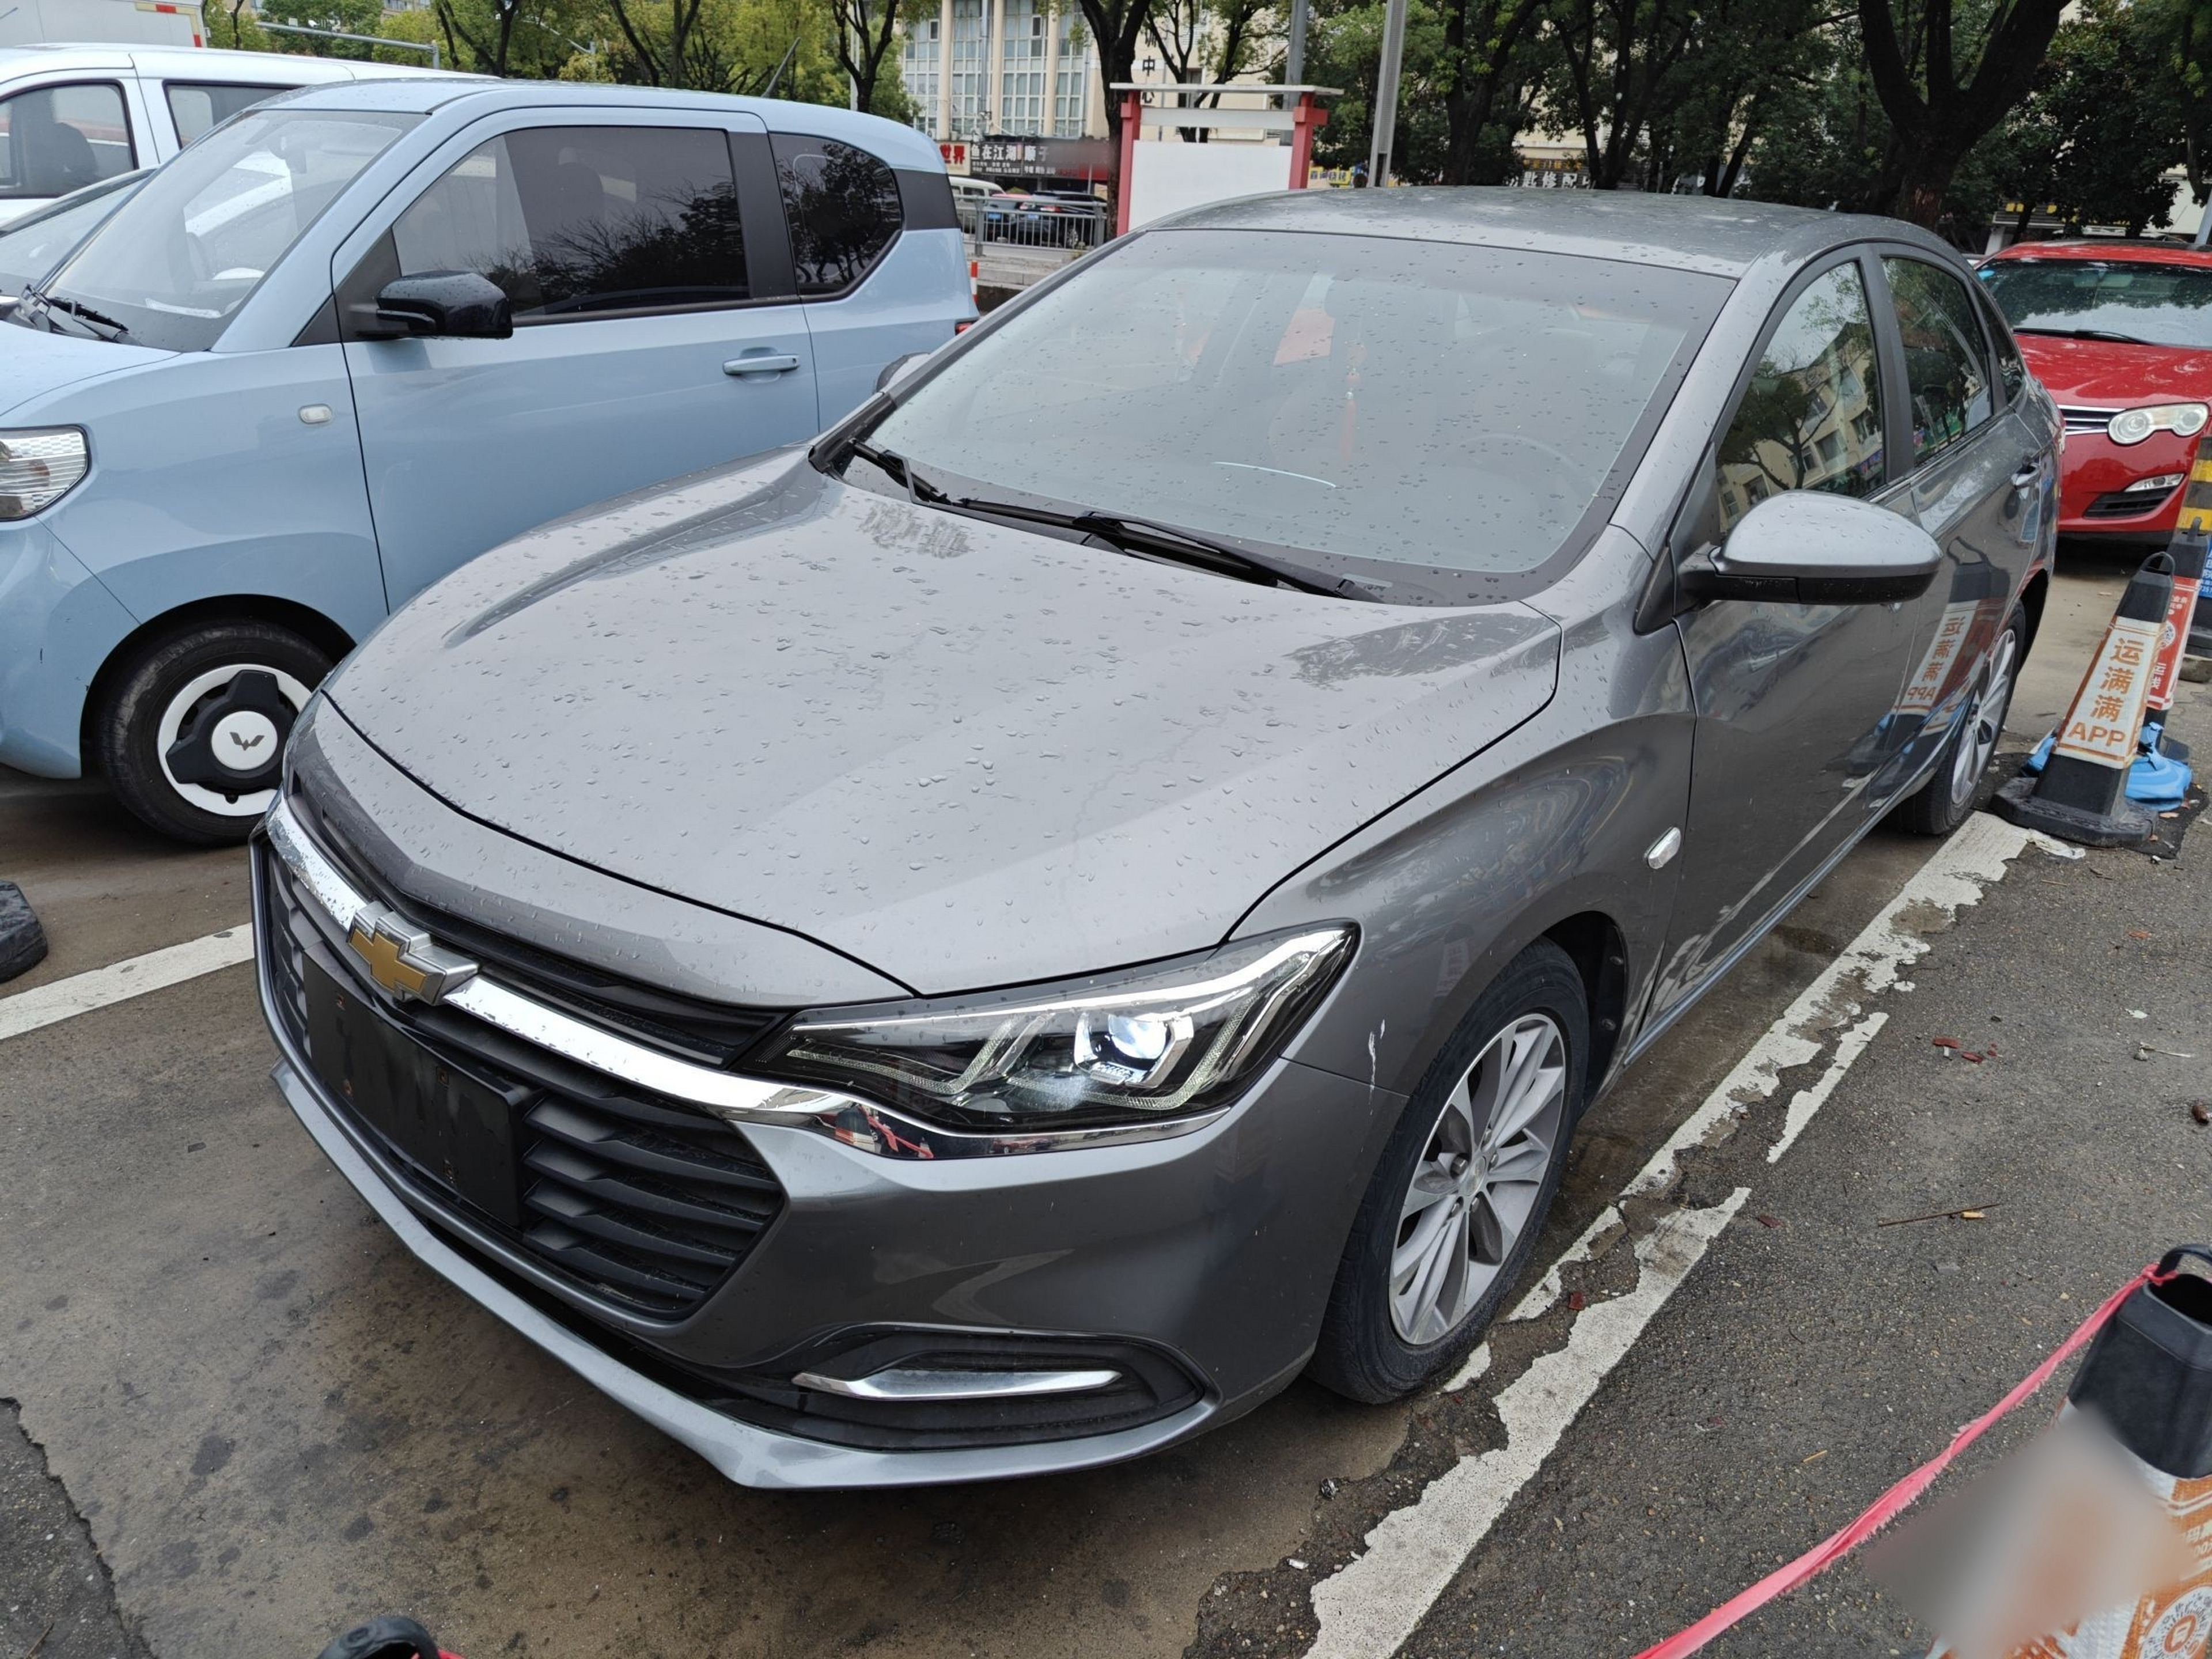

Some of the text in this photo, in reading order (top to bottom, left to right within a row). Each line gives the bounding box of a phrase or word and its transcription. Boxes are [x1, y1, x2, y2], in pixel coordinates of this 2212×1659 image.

[940, 145, 965, 164] 世界
[971, 145, 1016, 161] 鱼在江湖
[2090, 637, 2145, 722] 运满满
[2066, 721, 2127, 747] APP
